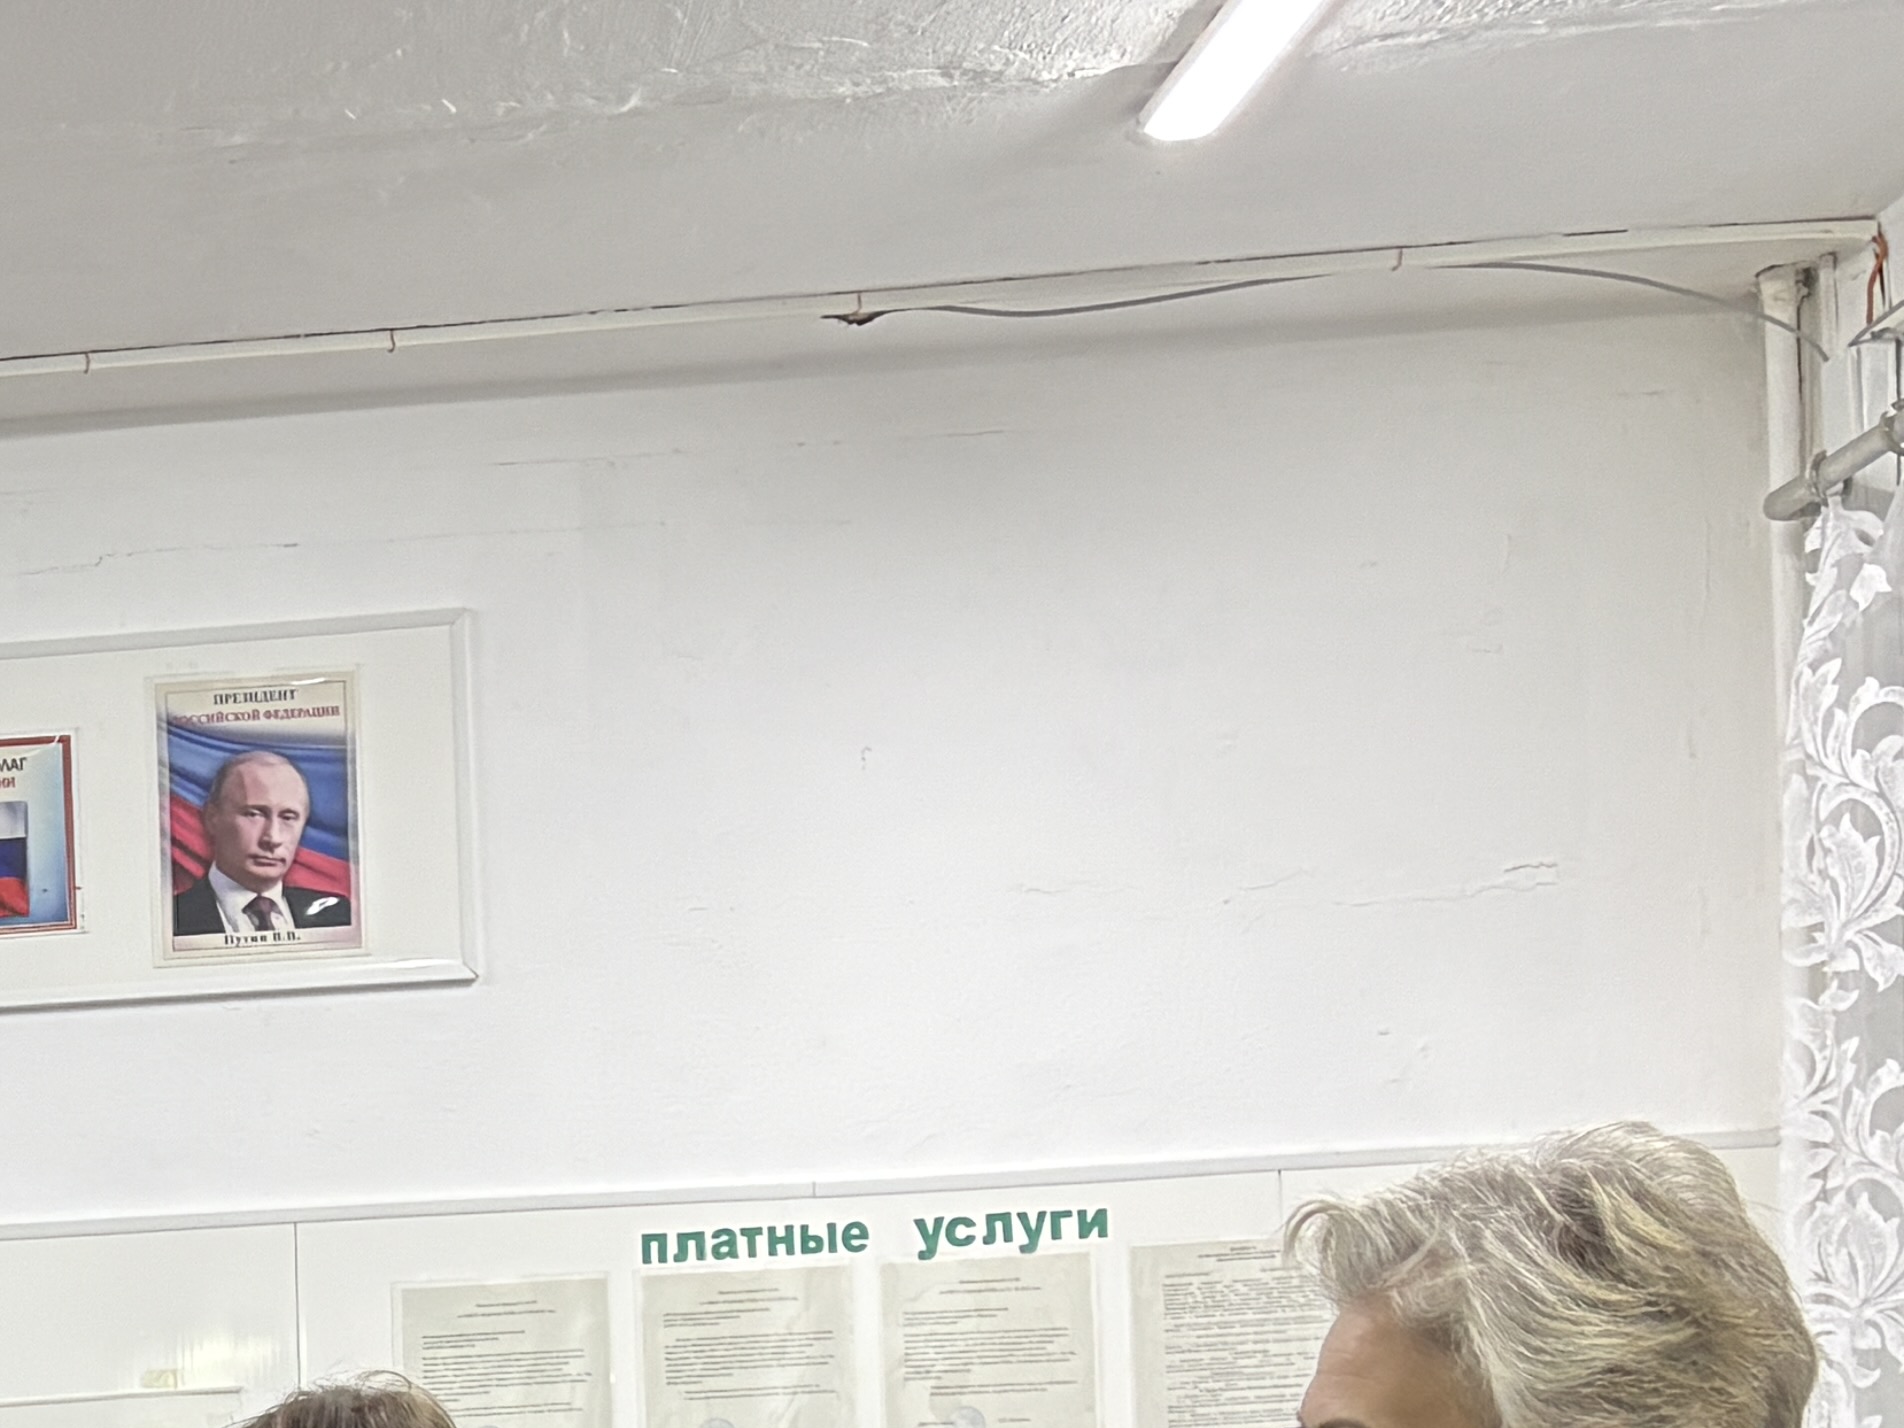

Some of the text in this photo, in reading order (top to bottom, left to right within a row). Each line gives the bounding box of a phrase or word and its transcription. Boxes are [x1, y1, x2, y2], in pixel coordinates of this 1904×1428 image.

[213, 688, 298, 706] ПРЕЗИДЕНТ
[639, 1207, 1110, 1265] платные услуги
